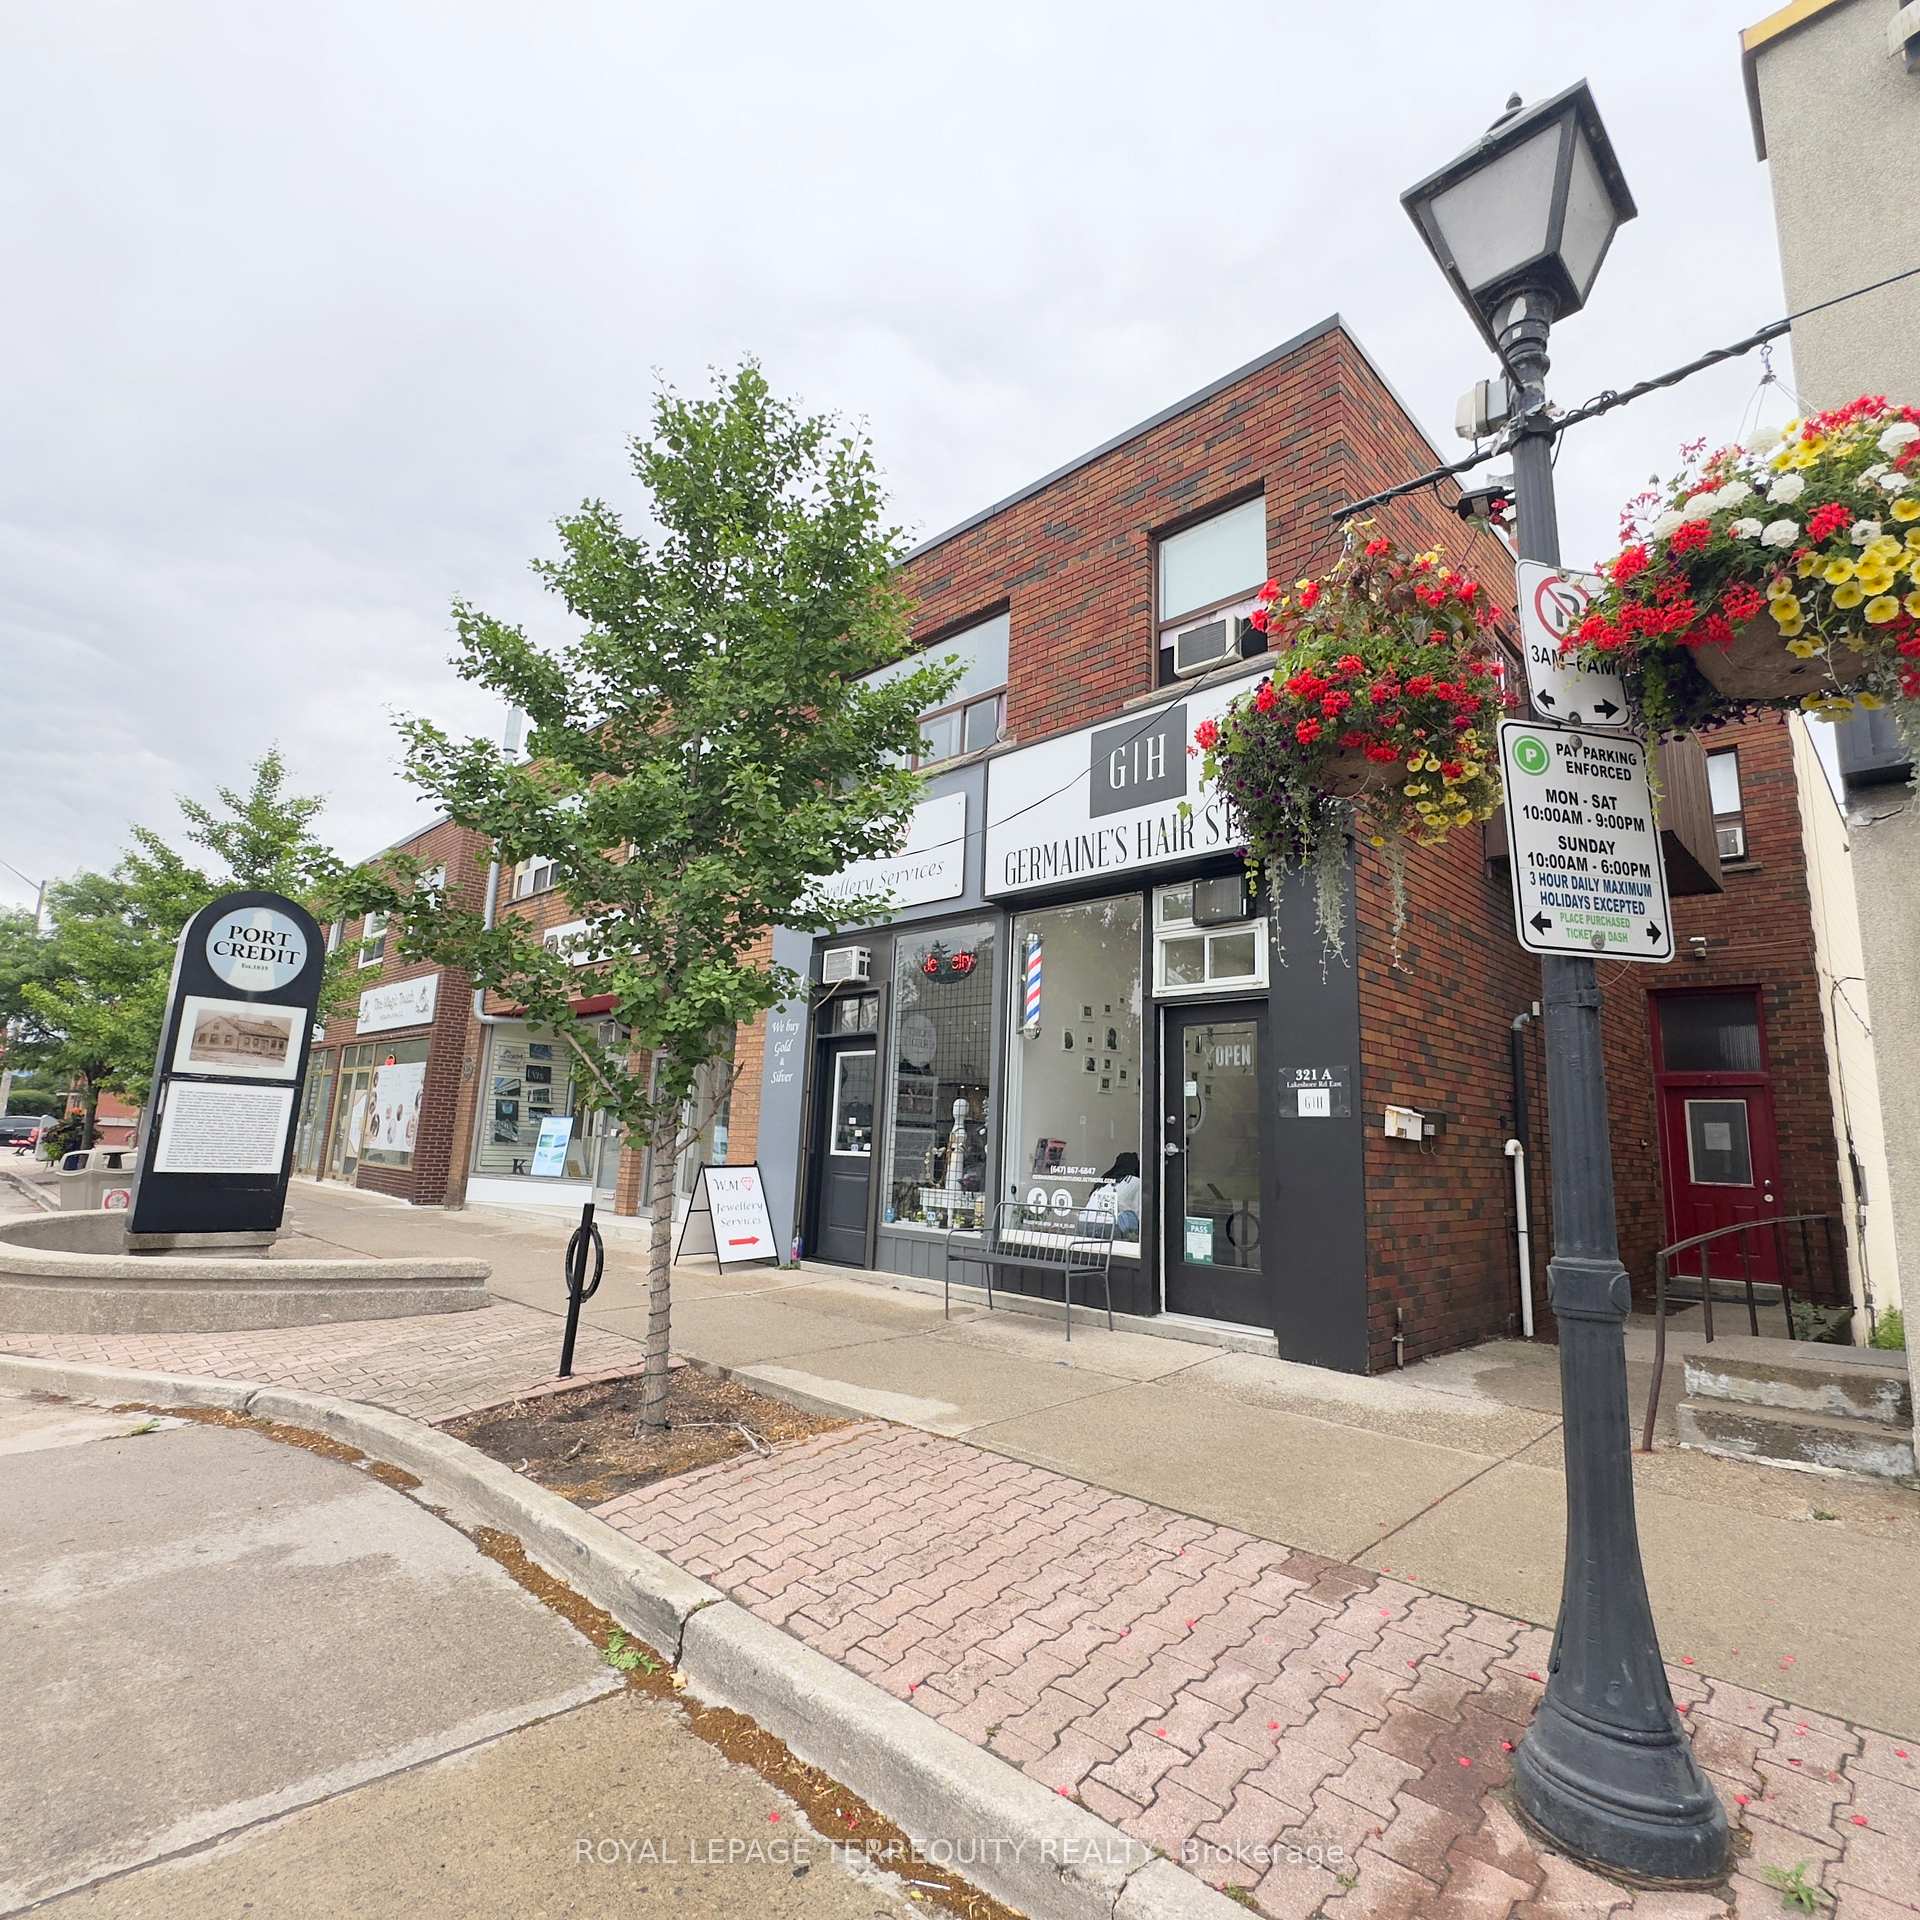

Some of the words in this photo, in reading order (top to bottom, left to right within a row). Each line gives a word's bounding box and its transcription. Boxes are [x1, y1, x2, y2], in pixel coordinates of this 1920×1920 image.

[1583, 746, 1637, 766] PARKING
[1566, 761, 1632, 781] ENFORCED
[1545, 789, 1579, 806] MON
[1591, 794, 1618, 810] SAT
[1523, 805, 1583, 825] 10:00AM
[1595, 813, 1646, 832] 9:00PM
[1005, 825, 1128, 886] GERMAINE'S
[1137, 811, 1195, 859] HAIR
[1558, 835, 1616, 855] SUNDAY
[879, 860, 945, 890] Services
[1528, 852, 1588, 872] 10:00AM
[1601, 859, 1651, 878] 6:00PM
[1530, 871, 1536, 885] 3
[1539, 872, 1569, 889] HOUR
[1571, 876, 1600, 892] DAILY
[1603, 879, 1652, 897] MAXIMUM
[1540, 891, 1591, 910] HOLIDAYS
[1594, 896, 1646, 915] EXCEPTED
[1560, 912, 1584, 925] PLACE
[1585, 914, 1631, 929] PURCHASED
[228, 925, 292, 947] PORT
[1566, 928, 1593, 940] TICKET
[1608, 932, 1628, 943] DASH
[213, 941, 301, 965] CREDIT
[771, 1021, 784, 1033] We
[785, 1019, 800, 1035] buy
[774, 1039, 793, 1056] Gold
[1215, 1044, 1251, 1066] OPEN
[771, 1070, 793, 1084] Silver
[1295, 1069, 1317, 1080] 321
[1321, 1068, 1332, 1080] A
[716, 1201, 763, 1215] Jewellery
[721, 1217, 761, 1226] Services
[1190, 1224, 1209, 1233] PASS
